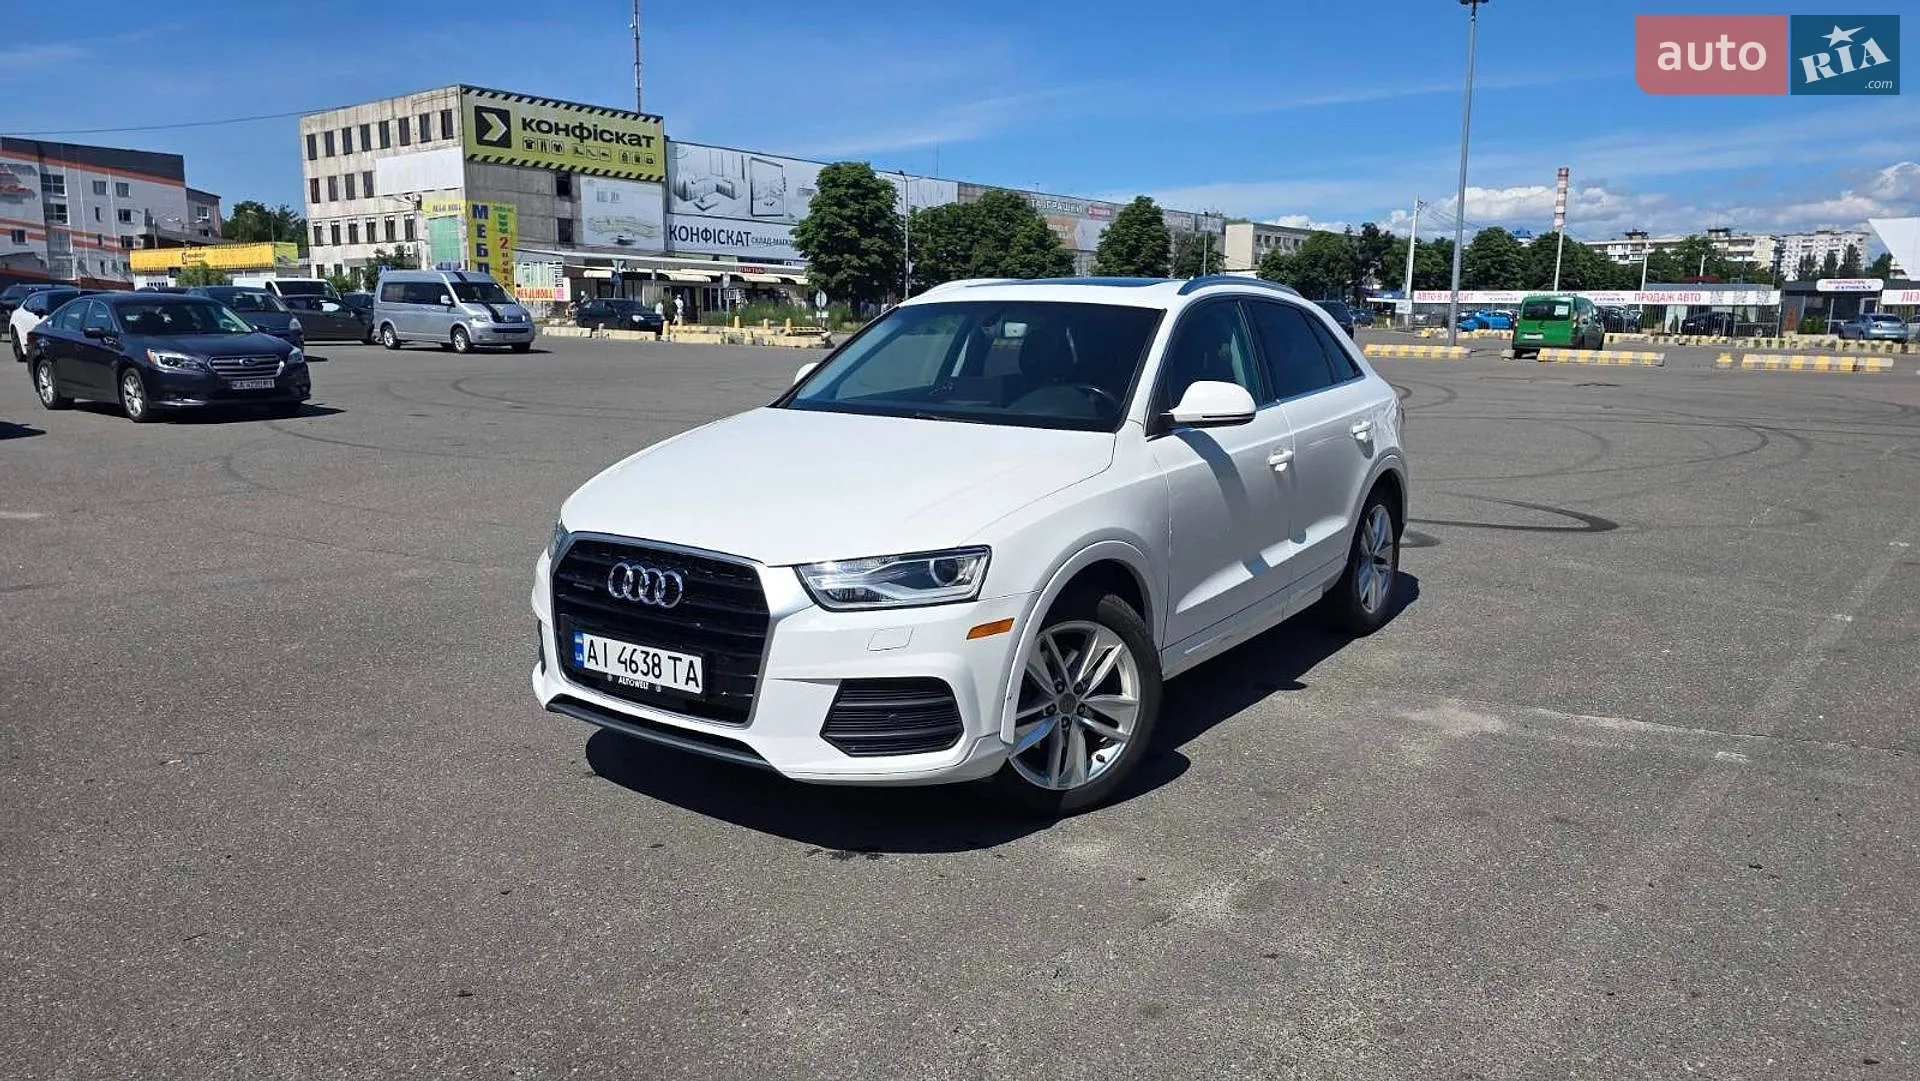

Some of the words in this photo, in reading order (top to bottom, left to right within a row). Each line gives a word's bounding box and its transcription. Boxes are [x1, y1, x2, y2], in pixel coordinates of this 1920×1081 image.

[521, 117, 655, 148] конфіскат
[669, 224, 752, 247] КОНФІСКАТ
[1634, 292, 1676, 303] ПРОДАЖ
[1677, 292, 1701, 302] АВТО
[587, 639, 608, 668] AI
[617, 646, 662, 679] 4638
[667, 655, 700, 688] TA
